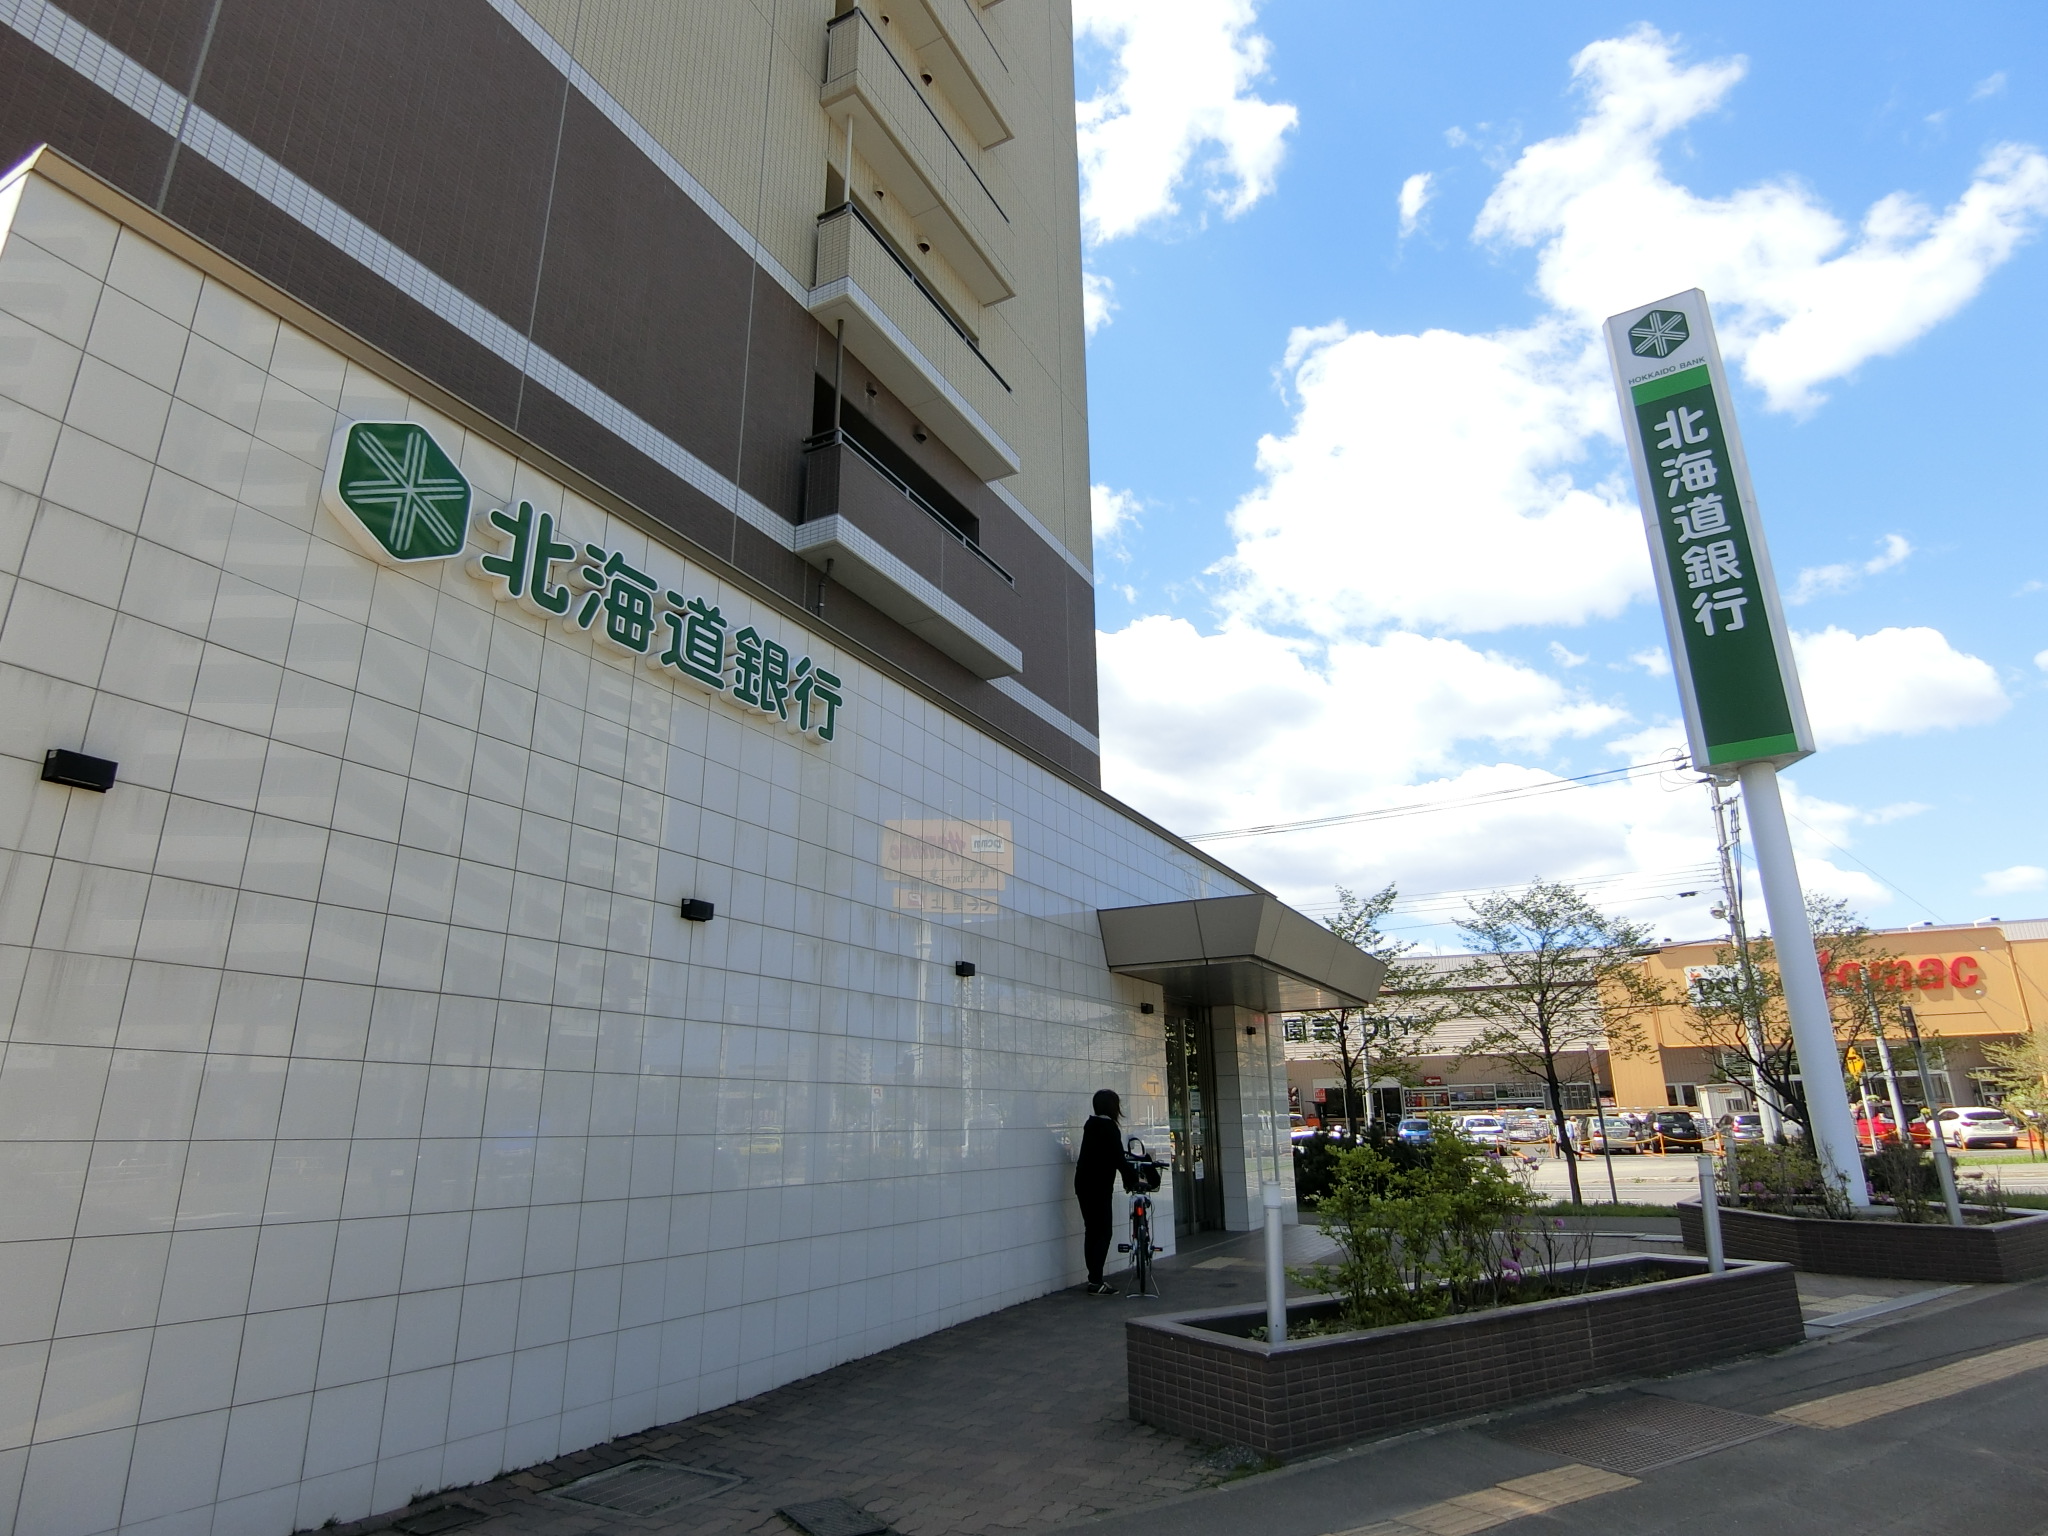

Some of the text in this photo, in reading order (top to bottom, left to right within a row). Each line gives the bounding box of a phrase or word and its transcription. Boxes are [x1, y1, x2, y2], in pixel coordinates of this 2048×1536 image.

[1628, 356, 1706, 385] HOKKAIDO BANK
[480, 499, 845, 744] 北海道銀行
[1653, 406, 1749, 637] 北海道銀行
